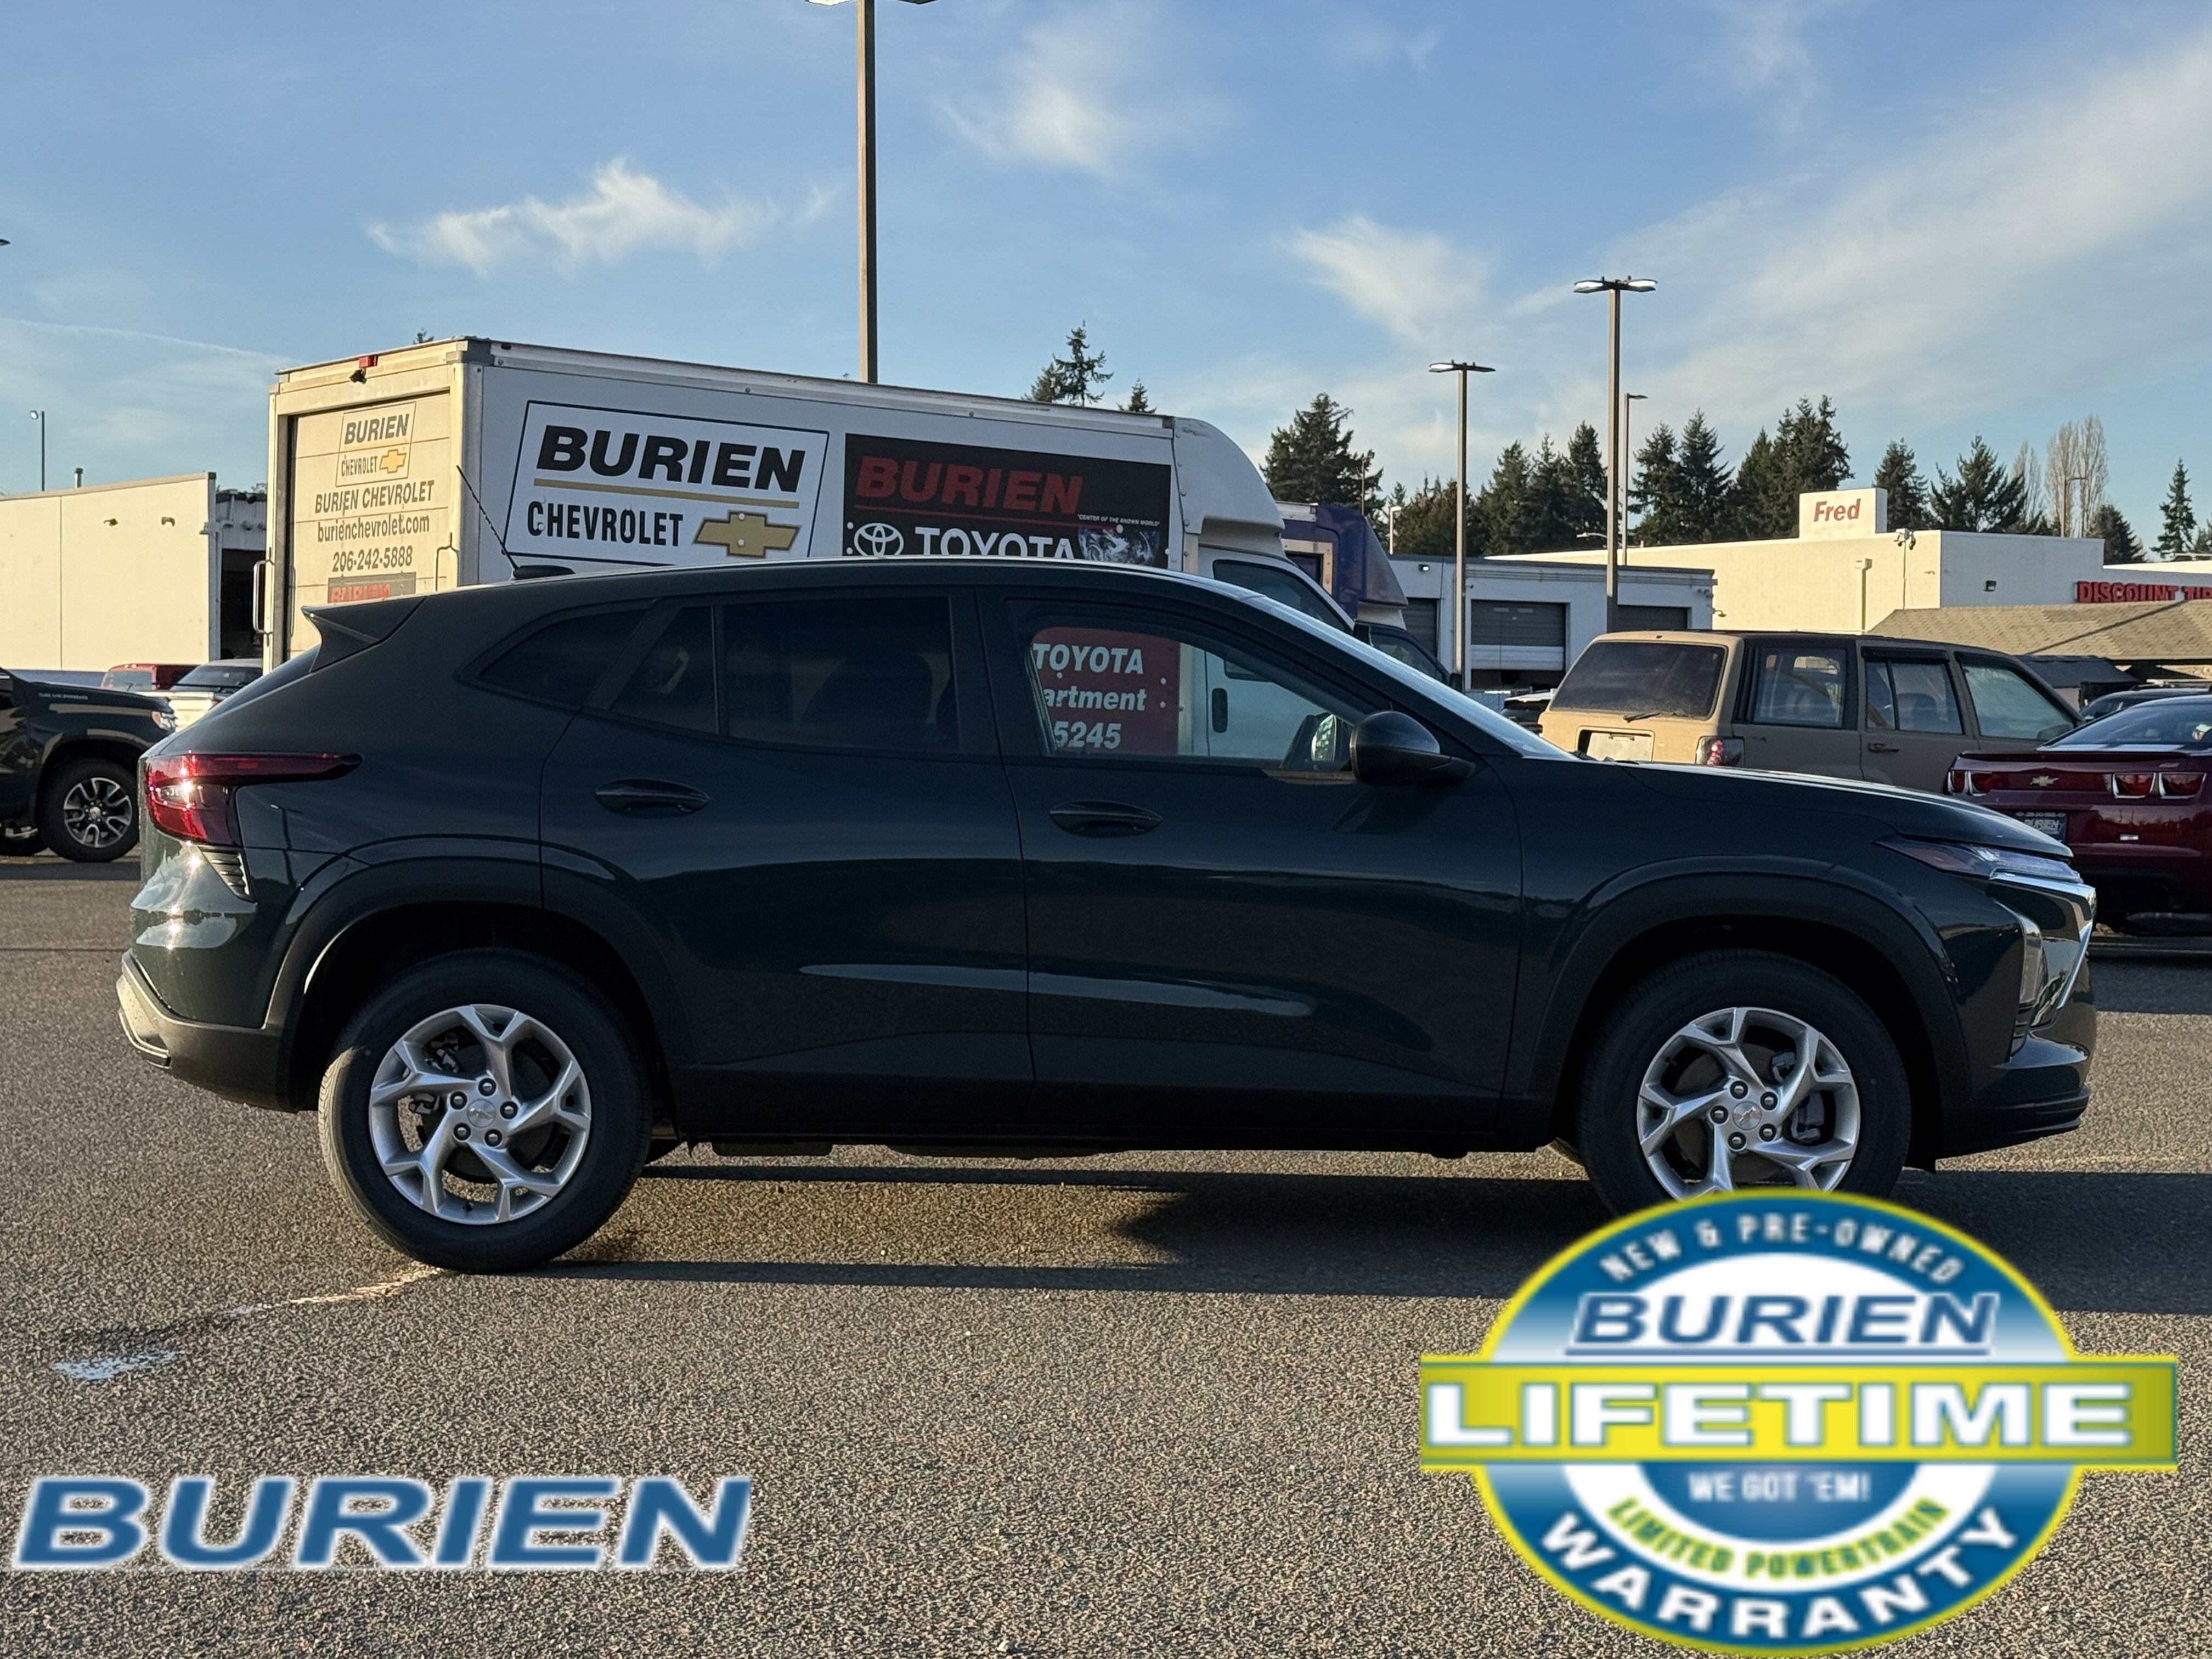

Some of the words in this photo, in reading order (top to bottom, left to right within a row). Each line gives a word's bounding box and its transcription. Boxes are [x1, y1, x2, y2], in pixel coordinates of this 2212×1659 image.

[345, 414, 409, 444] BURIEN
[341, 455, 378, 477] CHEVROLET
[537, 425, 805, 493] BURIEN
[315, 489, 359, 514] BURIEN
[362, 481, 435, 509] CHEVROLET
[855, 456, 1083, 515] BURIEN
[528, 501, 684, 548] CHEVROLET
[1814, 498, 1861, 522] Fred
[317, 514, 430, 543] burienchevrolet.com
[915, 527, 1075, 559] TOYOTA
[1032, 643, 1143, 674] TOYOTA
